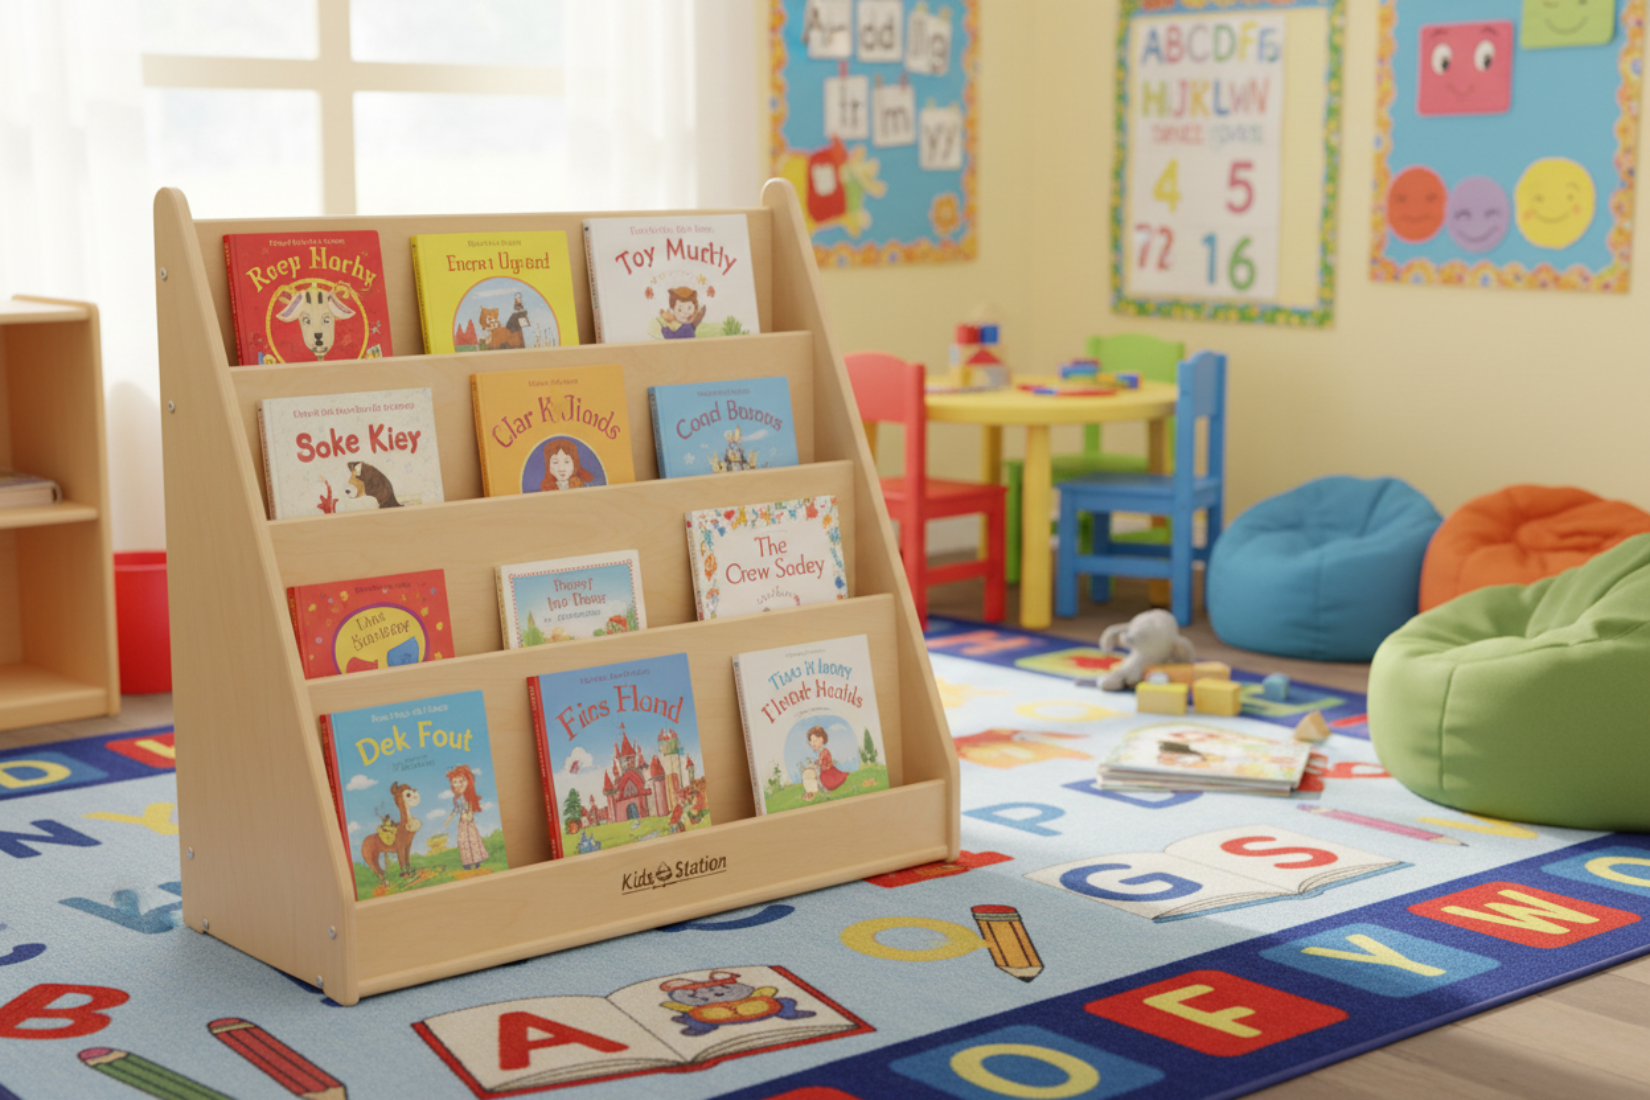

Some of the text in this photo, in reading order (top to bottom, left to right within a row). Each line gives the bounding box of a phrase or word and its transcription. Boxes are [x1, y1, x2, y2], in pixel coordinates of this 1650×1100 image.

[1153, 158, 1254, 214] 4 5
[615, 246, 655, 275] Toy
[296, 427, 360, 463] Soke
[754, 535, 788, 557] The
[725, 562, 770, 585] Crew
[355, 724, 412, 767] Dek
[417, 720, 473, 752] Fout
[962, 802, 1066, 837] P
[1220, 835, 1339, 870] S
[621, 855, 727, 891] Kids Station
[1059, 863, 1203, 902] G
[1440, 889, 1600, 935] W
[1300, 934, 1447, 977] Y
[0, 983, 131, 1039] B
[1142, 984, 1263, 1039] F
[498, 1012, 629, 1070] A
